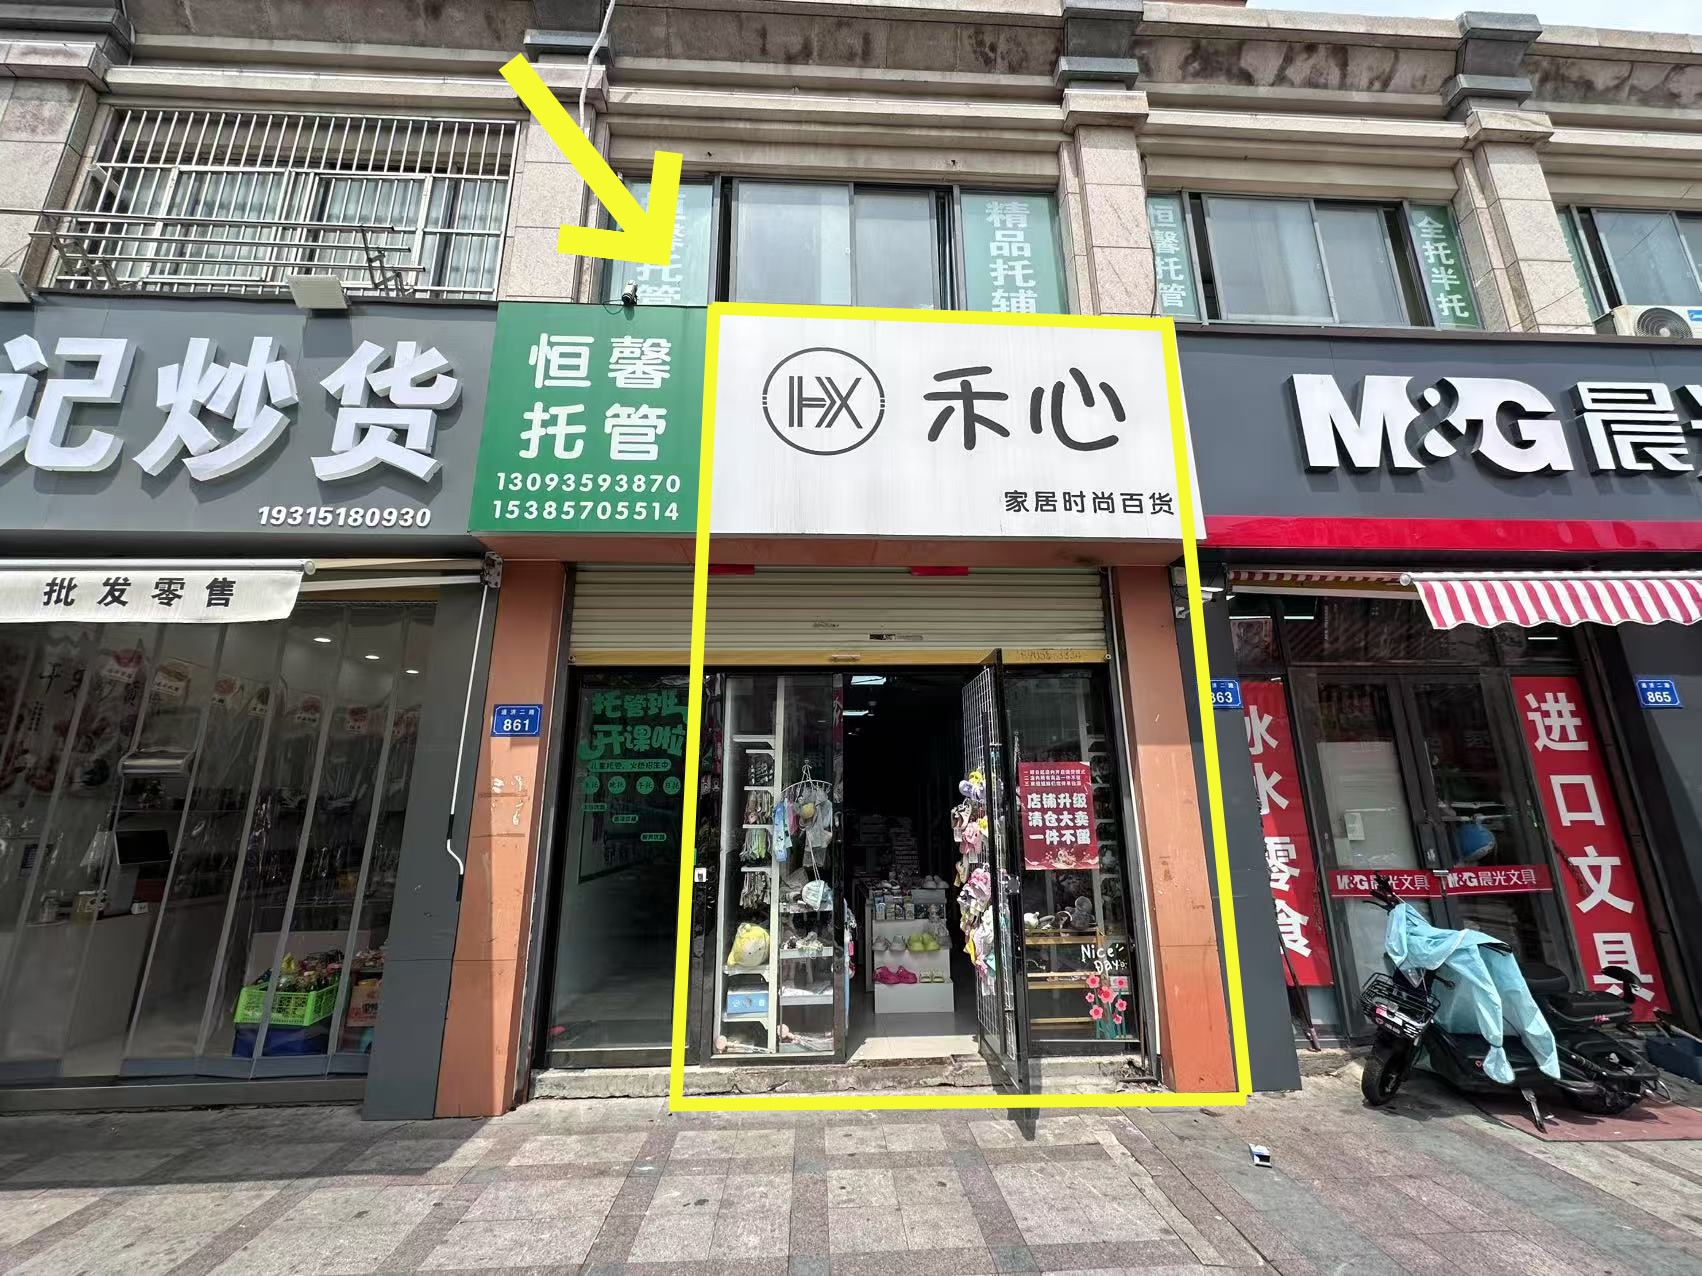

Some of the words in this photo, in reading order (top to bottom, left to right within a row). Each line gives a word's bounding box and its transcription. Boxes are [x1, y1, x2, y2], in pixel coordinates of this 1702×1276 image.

[637, 192, 686, 306] 托管
[985, 201, 1037, 313] 精品托辅
[1149, 204, 1186, 307] 恒馨托管
[1417, 216, 1470, 318] 全托半托
[528, 332, 672, 389] 恒馨
[0, 334, 463, 482] 记炒货
[923, 366, 1127, 451] 禾心
[518, 401, 668, 461] 托管
[497, 472, 681, 493] 13093593870
[257, 505, 432, 528] 19315180930
[493, 500, 679, 521] 15385705514
[1004, 489, 1175, 516] 家居时尚百货
[43, 576, 237, 608] 批发零售
[1647, 691, 1671, 702] 865
[503, 718, 530, 731] 861
[577, 724, 686, 758] 开课啦
[1027, 793, 1088, 809] 店铺升级
[1028, 810, 1090, 827] 清仓大卖
[1525, 692, 1655, 1002] 进口文具
[1081, 943, 1115, 963] Nice
